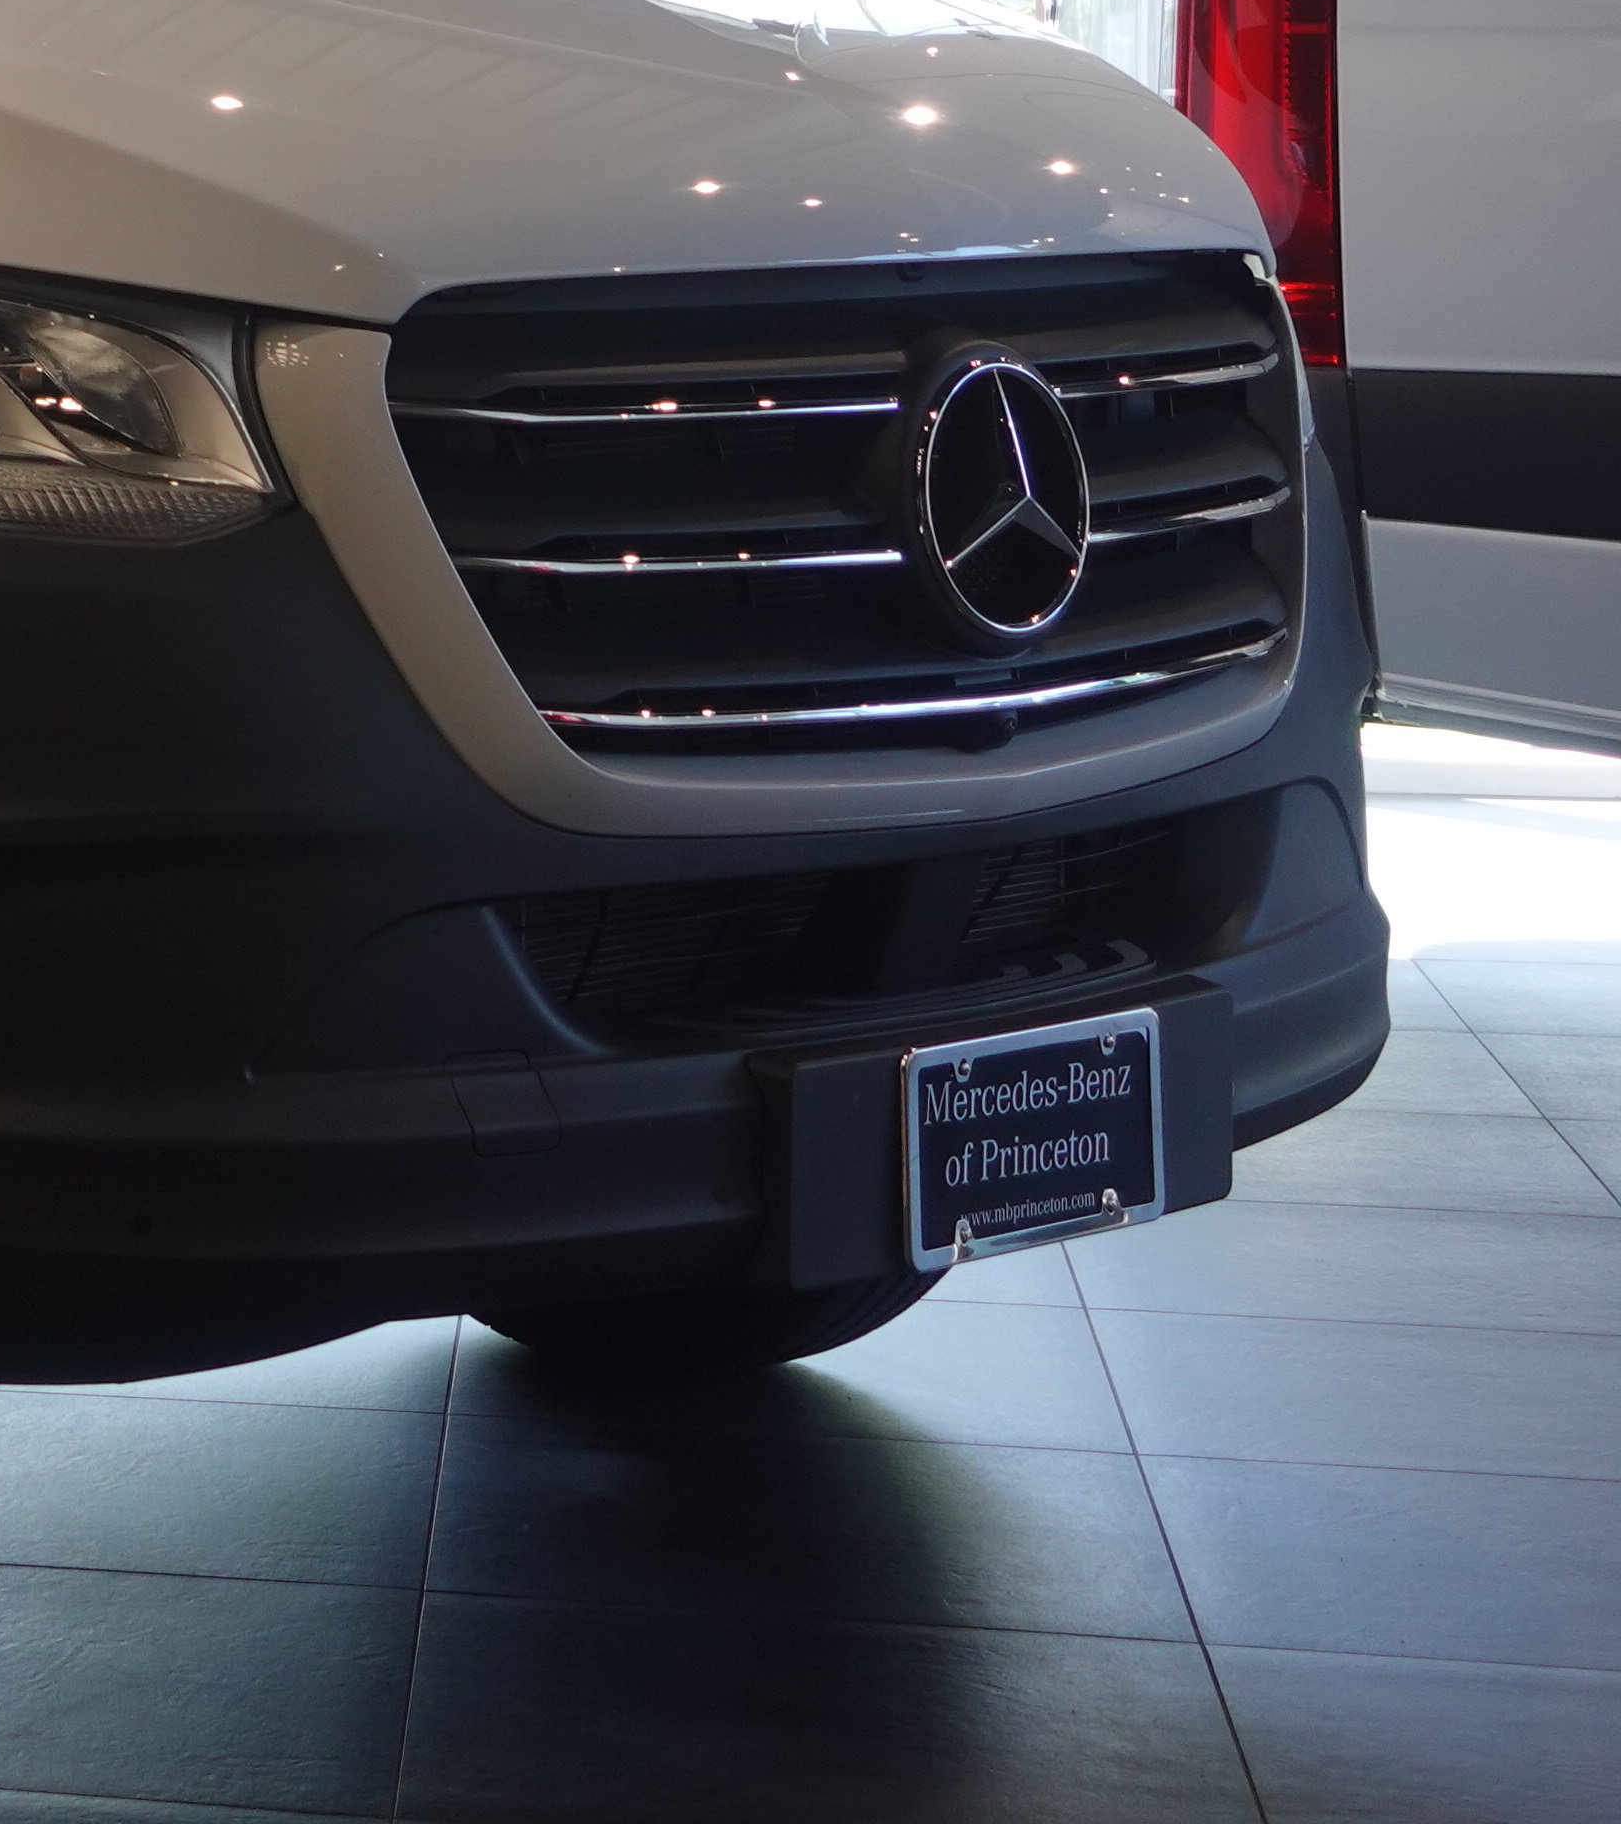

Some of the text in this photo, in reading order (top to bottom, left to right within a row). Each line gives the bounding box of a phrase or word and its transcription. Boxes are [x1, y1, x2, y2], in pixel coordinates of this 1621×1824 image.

[924, 1062, 1131, 1125] Mercedes-Benz
[946, 1130, 1109, 1186] of Princeton
